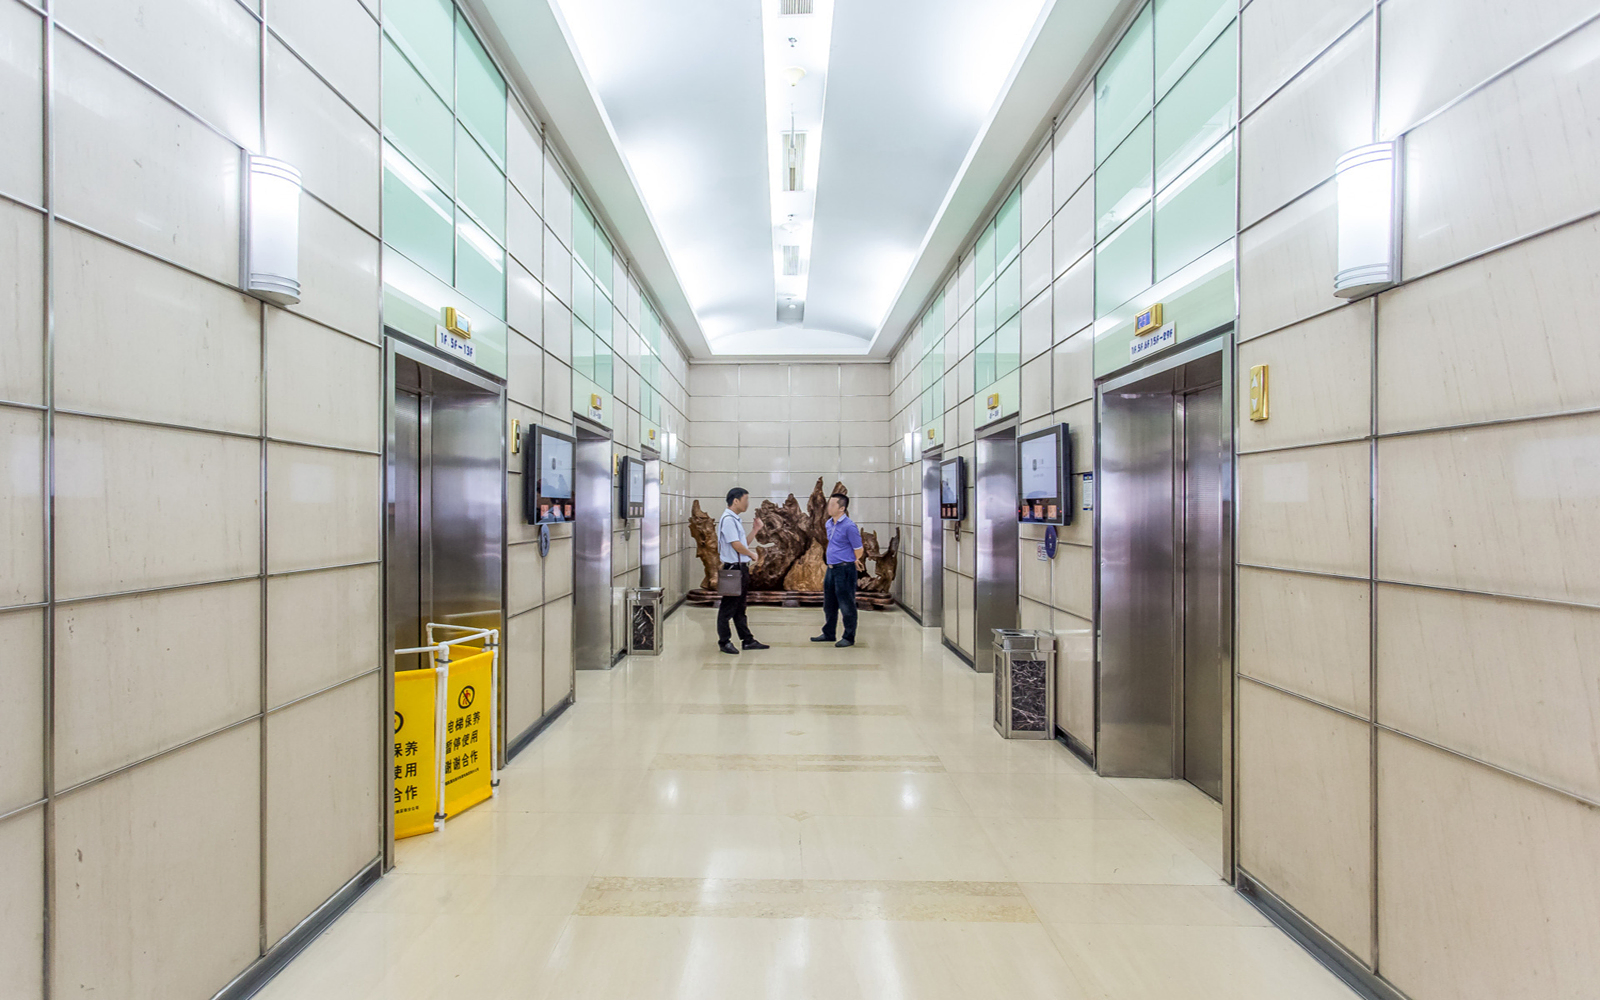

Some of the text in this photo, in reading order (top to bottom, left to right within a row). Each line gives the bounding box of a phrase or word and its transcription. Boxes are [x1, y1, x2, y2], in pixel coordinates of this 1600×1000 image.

[447, 711, 480, 734] 电梯保养
[446, 730, 478, 755] 暂停使用
[445, 750, 478, 774] 谢谢合作
